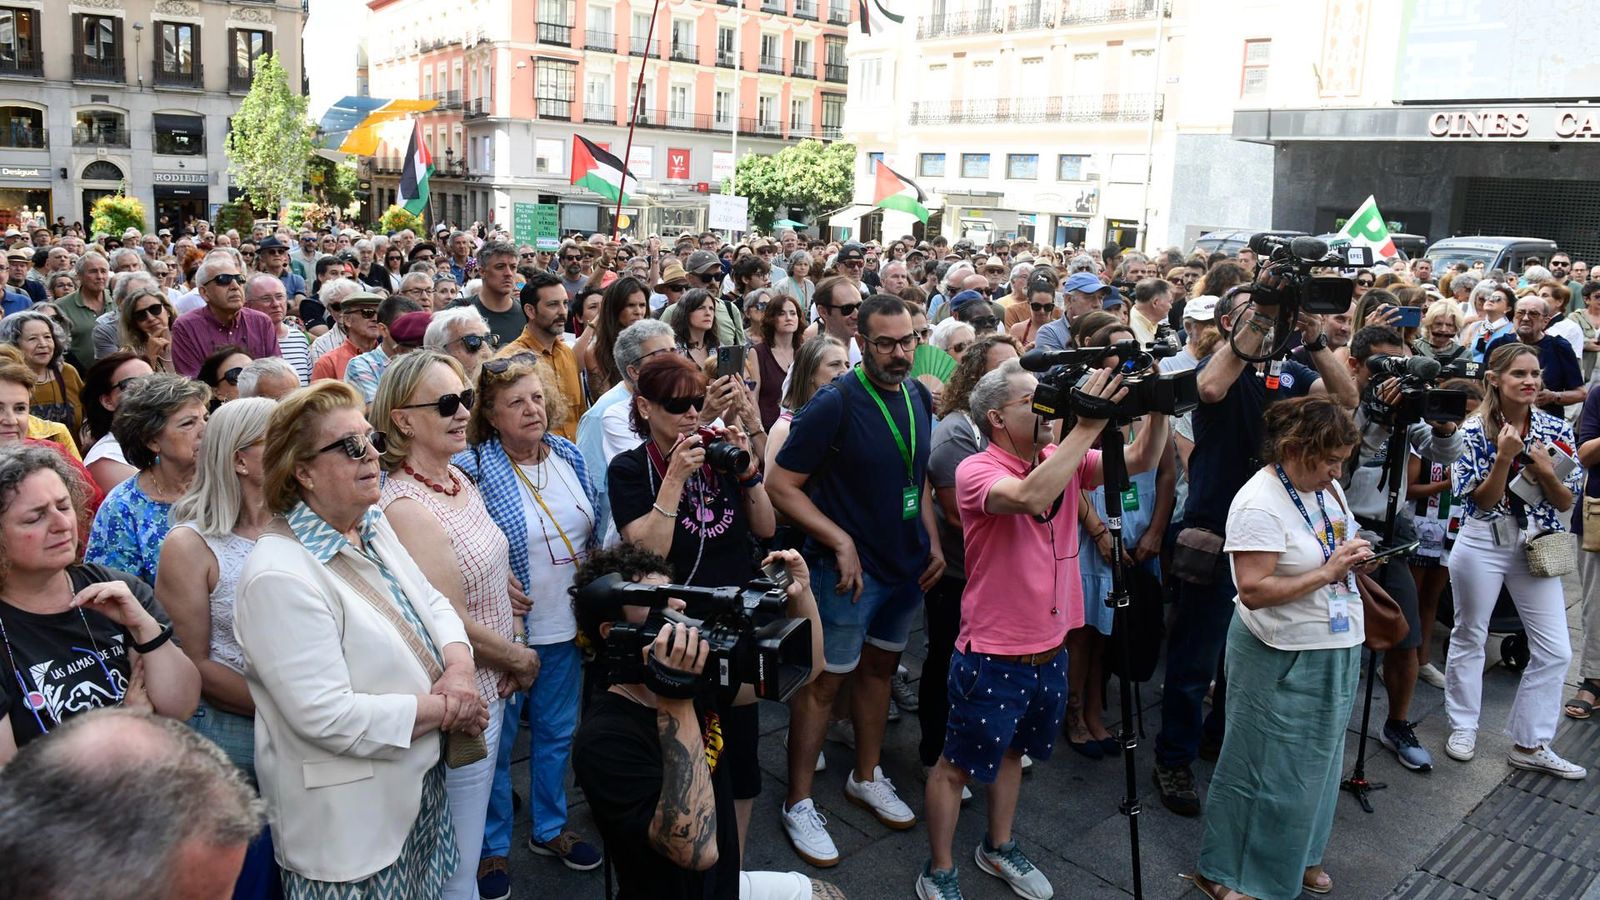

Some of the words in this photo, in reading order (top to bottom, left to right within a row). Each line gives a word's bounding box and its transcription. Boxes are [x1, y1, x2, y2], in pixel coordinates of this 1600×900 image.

[1428, 111, 1529, 138] CINES
[1555, 111, 1600, 139] CA
[155, 173, 206, 183] RODILLA
[682, 517, 699, 534] MY
[51, 667, 66, 680] LAS
[67, 655, 95, 675] ALMAS
[97, 649, 110, 661] DE
